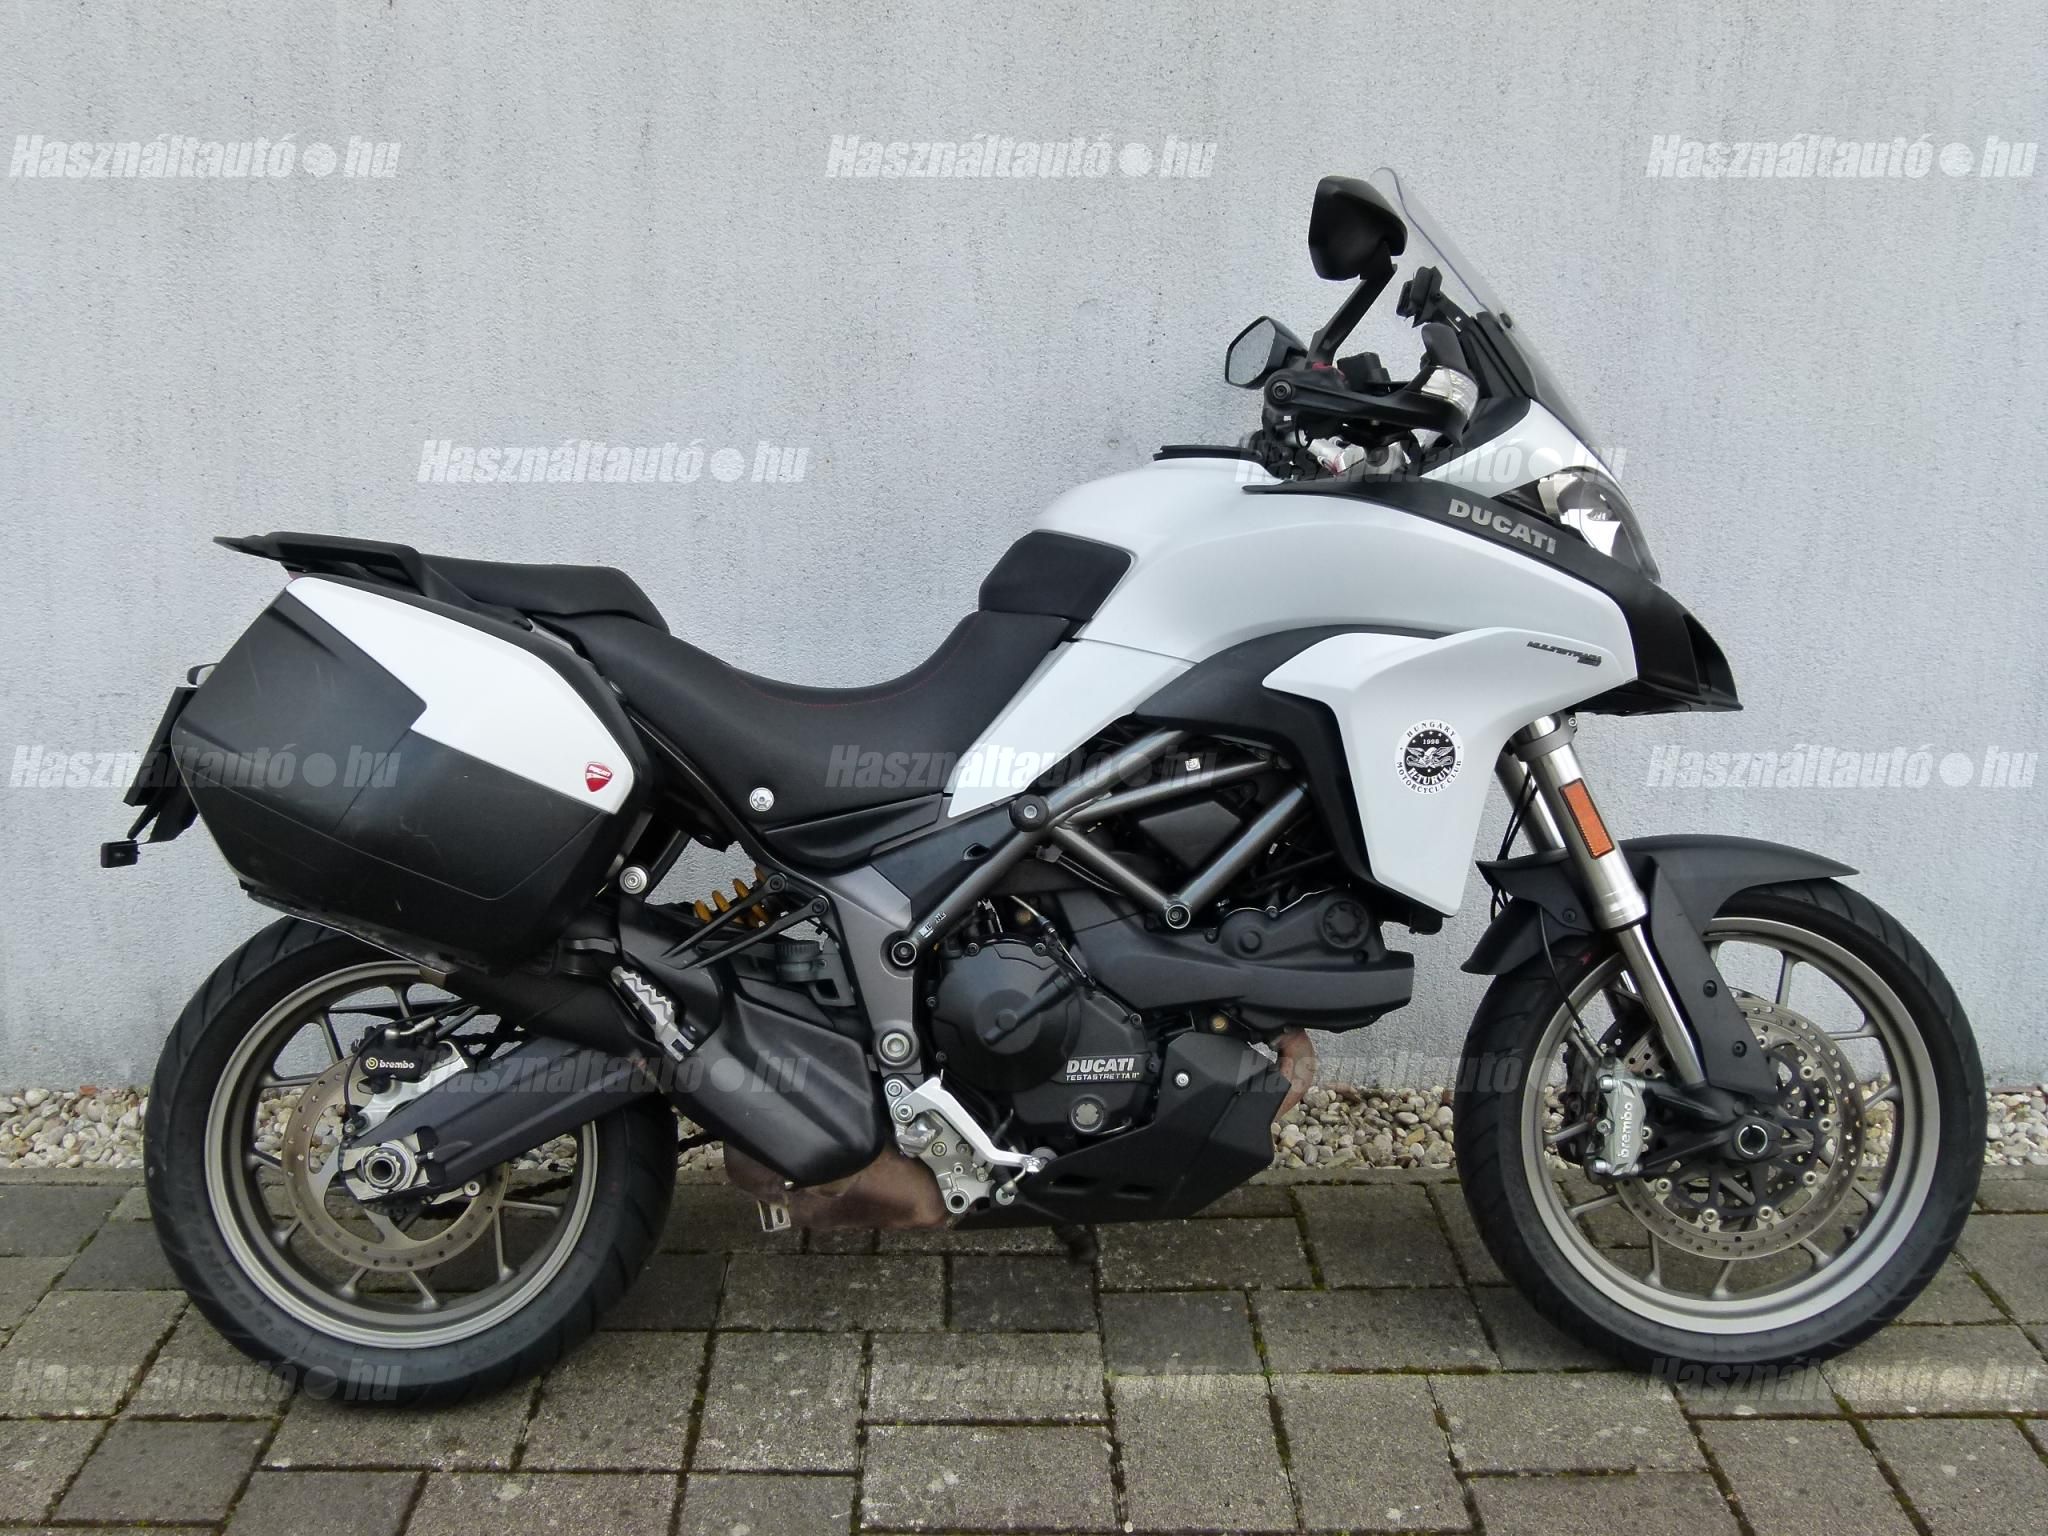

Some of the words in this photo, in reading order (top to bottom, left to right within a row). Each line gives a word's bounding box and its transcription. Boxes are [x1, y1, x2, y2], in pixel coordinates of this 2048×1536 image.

[1448, 499, 1557, 555] DUCATI
[1406, 721, 1456, 738] HUNGARY
[1397, 761, 1446, 794] MOTORCYCLE
[1446, 760, 1462, 784] CLUB
[379, 1060, 415, 1069] brembo
[1066, 1057, 1135, 1074] DUCATI
[1066, 1072, 1131, 1081] TESTASTRETTA
[1618, 1102, 1633, 1158] brembo
